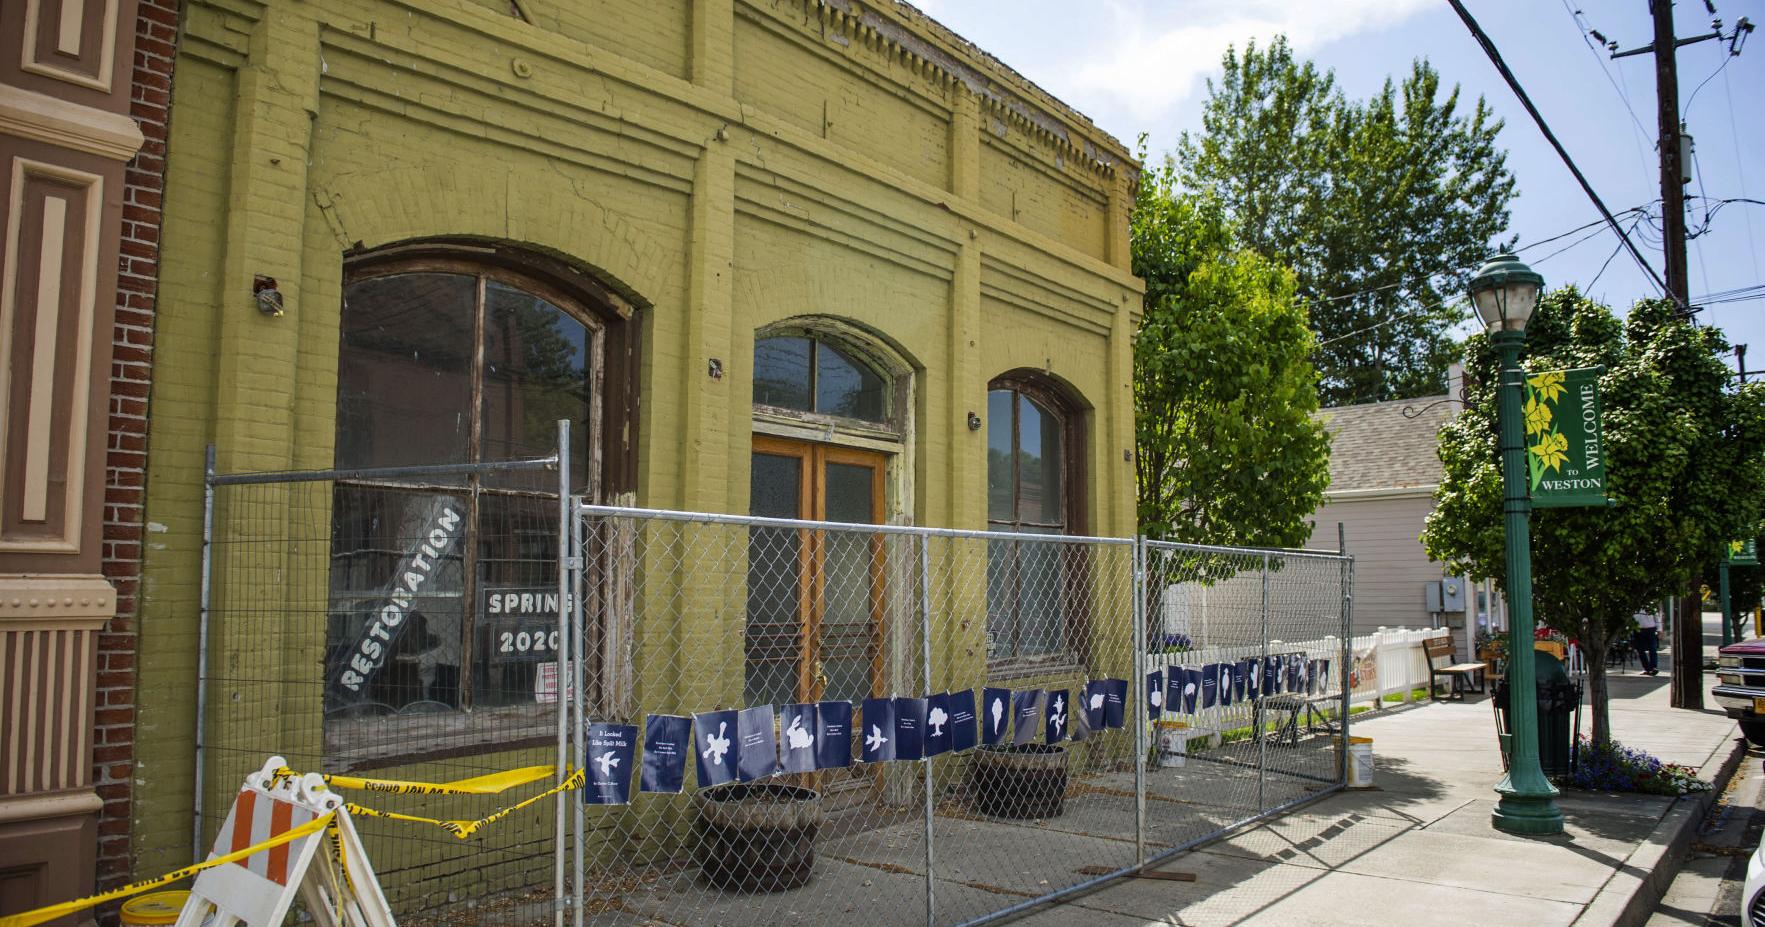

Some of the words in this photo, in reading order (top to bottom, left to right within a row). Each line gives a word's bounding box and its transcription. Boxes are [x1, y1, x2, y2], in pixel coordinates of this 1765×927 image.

[1580, 384, 1600, 470] WELCOME
[1542, 478, 1601, 490] WESTON
[341, 507, 460, 692] RESTORATION
[500, 631, 559, 653] 2020
